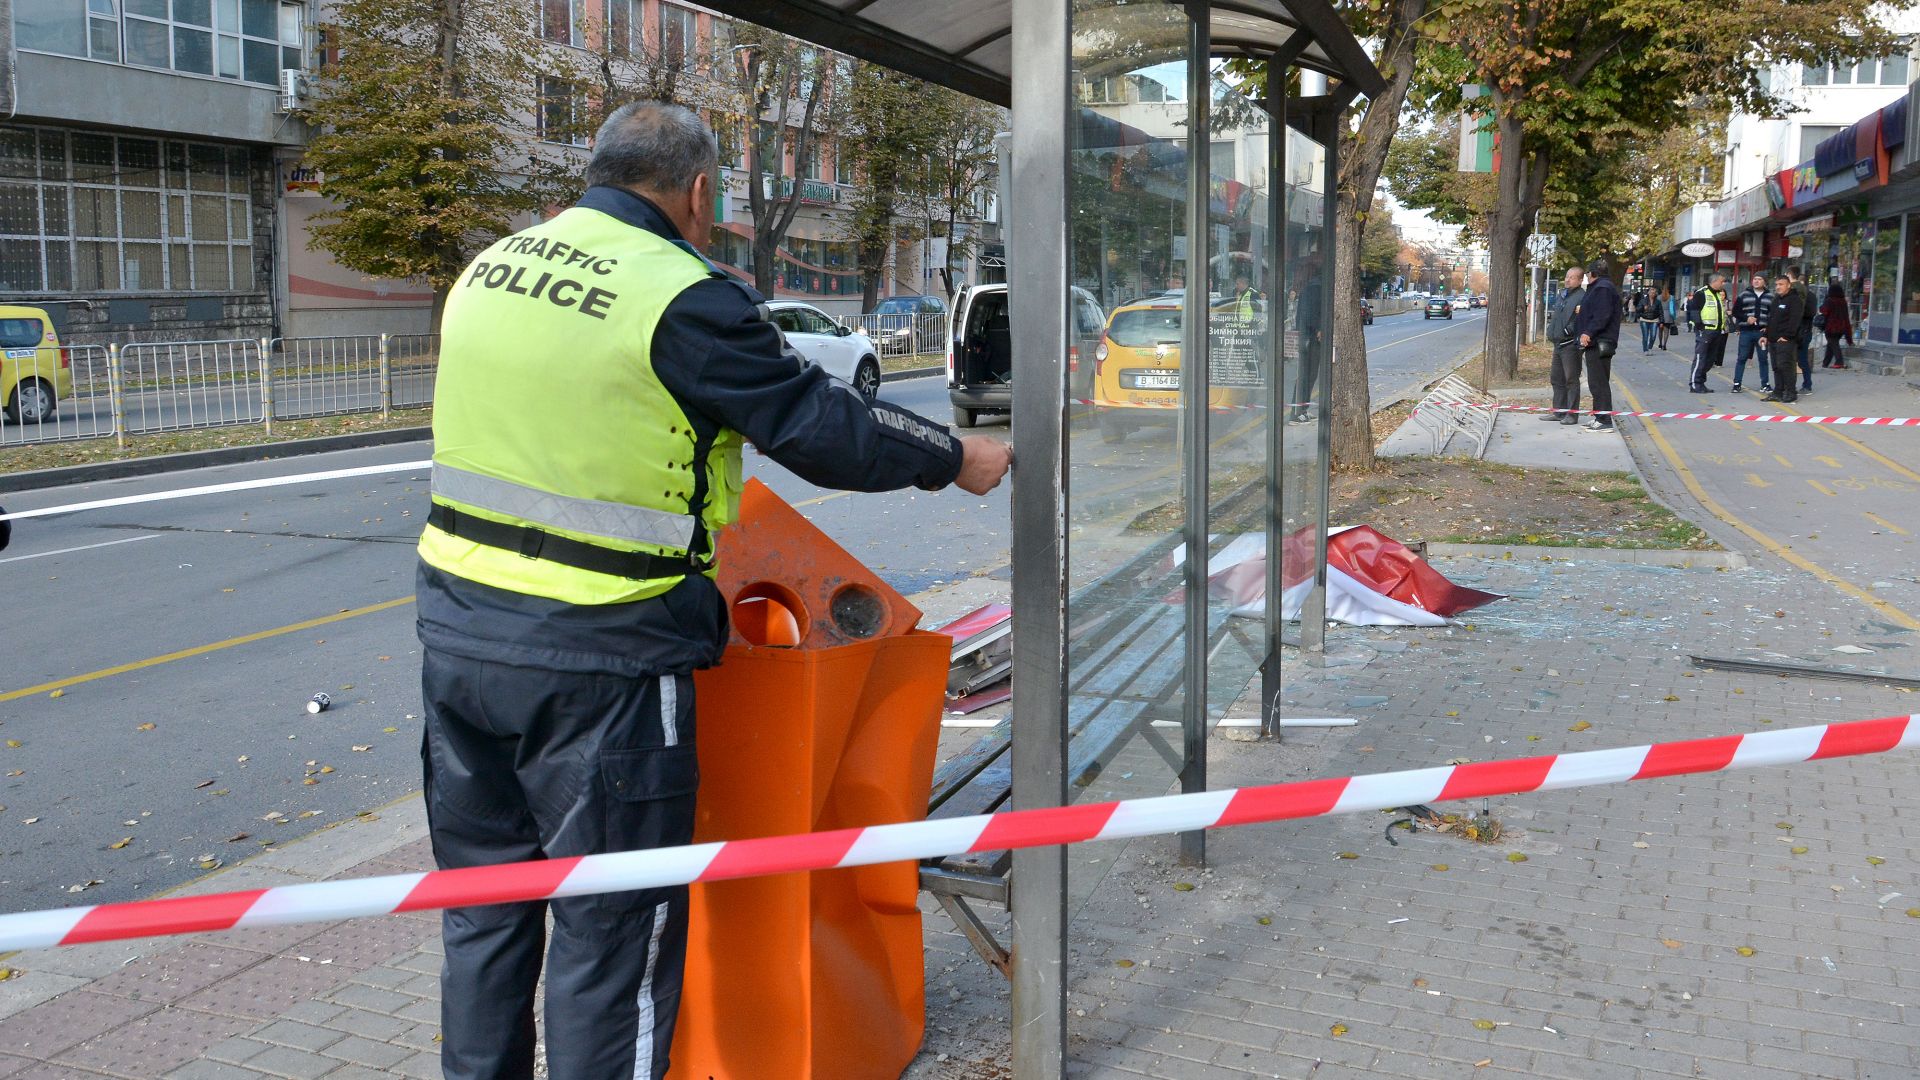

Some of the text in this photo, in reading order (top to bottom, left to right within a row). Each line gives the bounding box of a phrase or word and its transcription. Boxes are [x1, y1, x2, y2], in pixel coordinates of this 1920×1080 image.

[502, 236, 618, 275] TRAFFIC
[466, 262, 618, 320] POLICE
[1209, 327, 1239, 335] Зимно
[1219, 336, 1252, 346] Тракия
[1152, 377, 1168, 385] 1164
